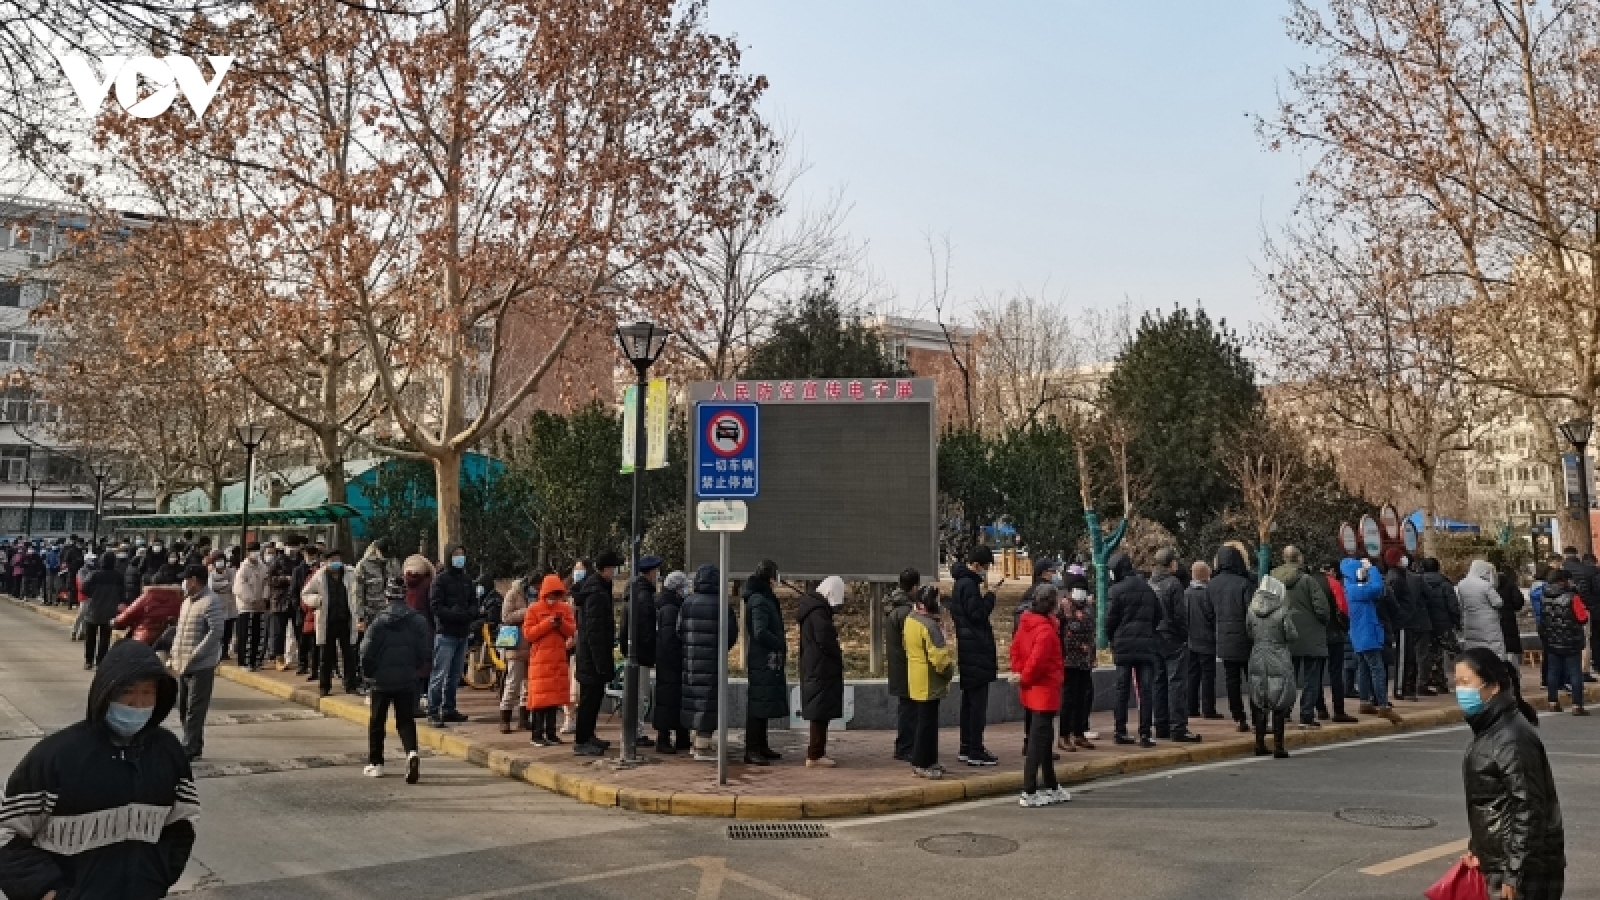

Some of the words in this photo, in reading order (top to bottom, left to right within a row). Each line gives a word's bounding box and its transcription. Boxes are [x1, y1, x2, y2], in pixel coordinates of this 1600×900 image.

[711, 380, 914, 401] 人民防空宣传电子屏
[701, 457, 755, 473] 一切车辆
[701, 474, 755, 490] 禁止停放
